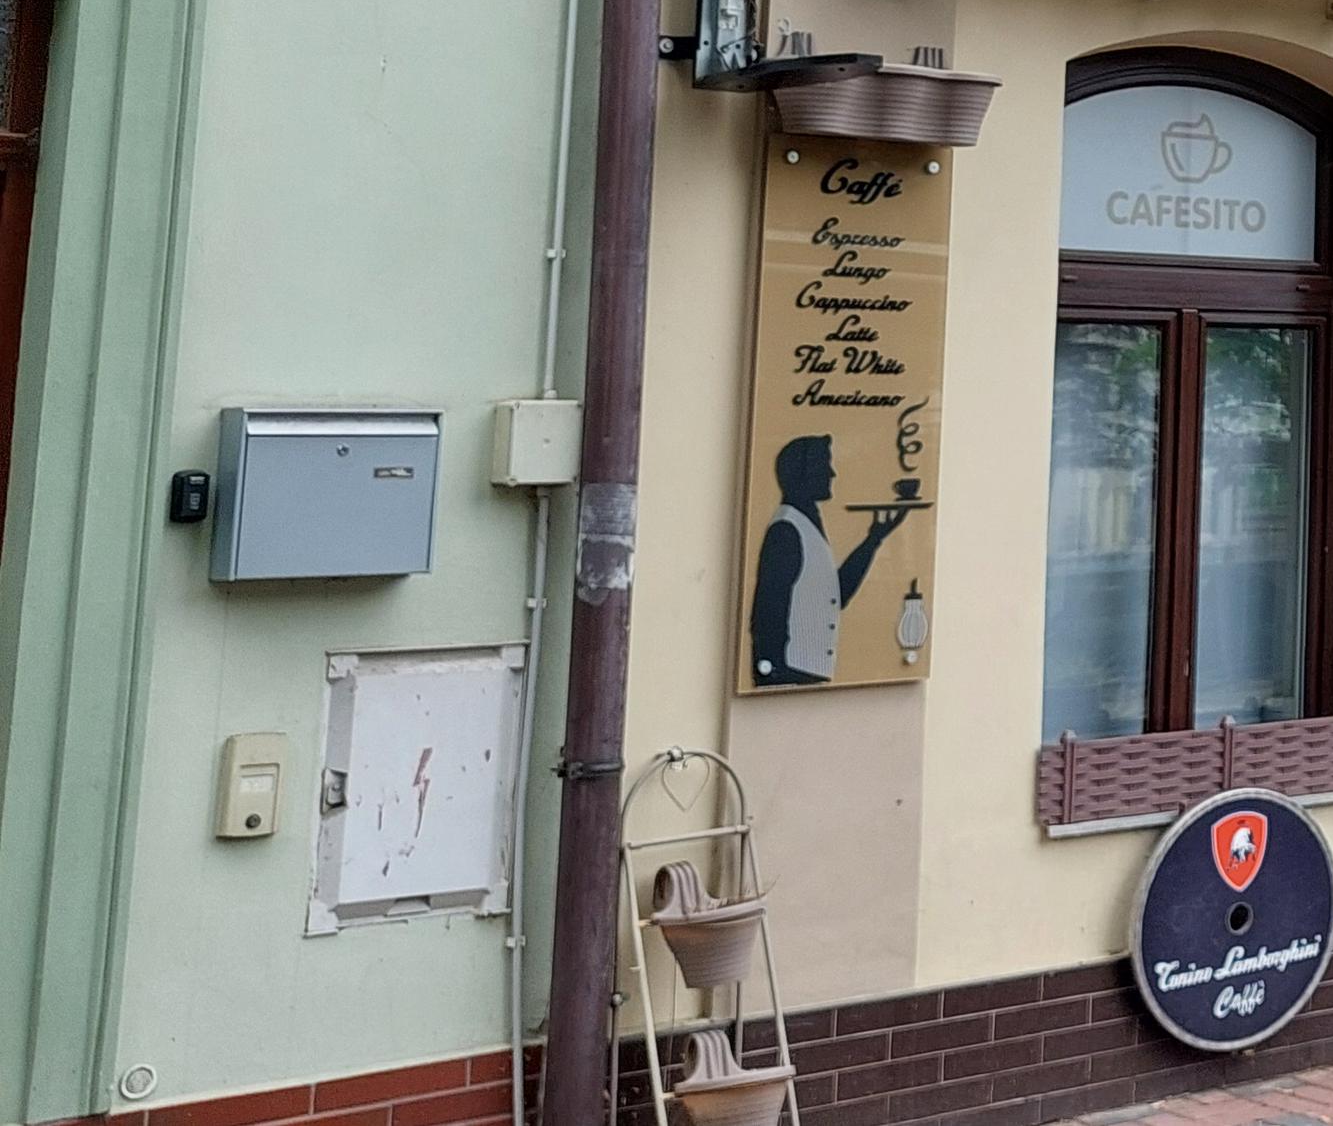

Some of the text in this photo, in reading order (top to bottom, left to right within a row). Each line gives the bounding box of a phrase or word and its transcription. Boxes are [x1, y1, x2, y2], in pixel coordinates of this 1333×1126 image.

[1106, 190, 1267, 233] CAFESITO
[811, 217, 907, 250] Espresso
[822, 250, 892, 285] Lungo
[795, 280, 914, 315] Cappuccino
[825, 314, 880, 342] Latte
[794, 345, 906, 375] Flat White
[792, 379, 907, 407] Americano
[1154, 934, 1323, 993] Tonino Lamborghini
